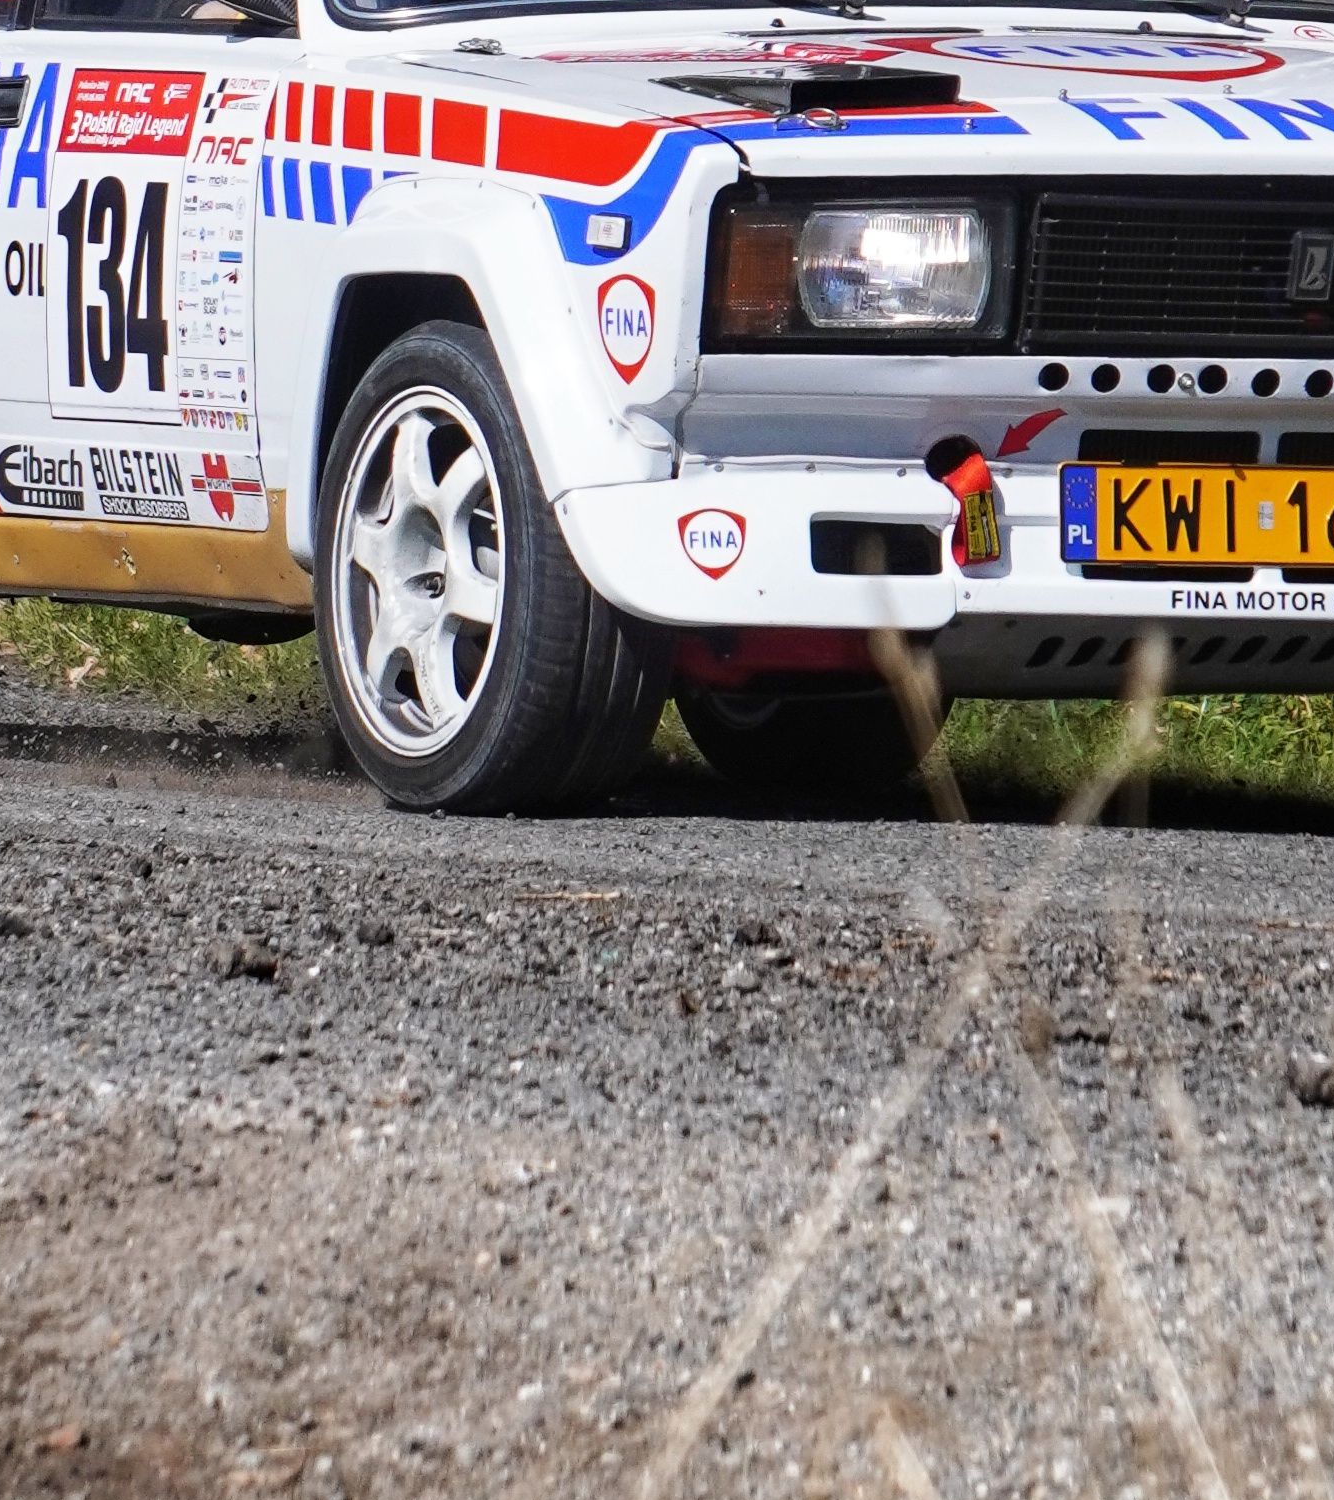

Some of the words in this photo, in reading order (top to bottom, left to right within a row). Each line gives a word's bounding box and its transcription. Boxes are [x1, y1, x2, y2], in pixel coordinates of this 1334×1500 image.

[953, 44, 1253, 59] FINA
[68, 110, 83, 143] 3
[82, 111, 120, 134] Polski
[119, 112, 146, 139] Rajd
[146, 114, 189, 142] Legend
[5, 240, 46, 297] OIL
[57, 176, 170, 394] 134
[605, 308, 648, 338] FINA
[89, 447, 185, 497] BILSTEIN
[103, 496, 134, 515] SHOCK
[135, 498, 189, 520] ABSORBERS
[1112, 478, 1237, 552] KWI
[689, 530, 738, 549] FINA
[1068, 525, 1093, 544] PL
[1171, 590, 1218, 610] FINA
[1227, 591, 1316, 611] MOTOR
